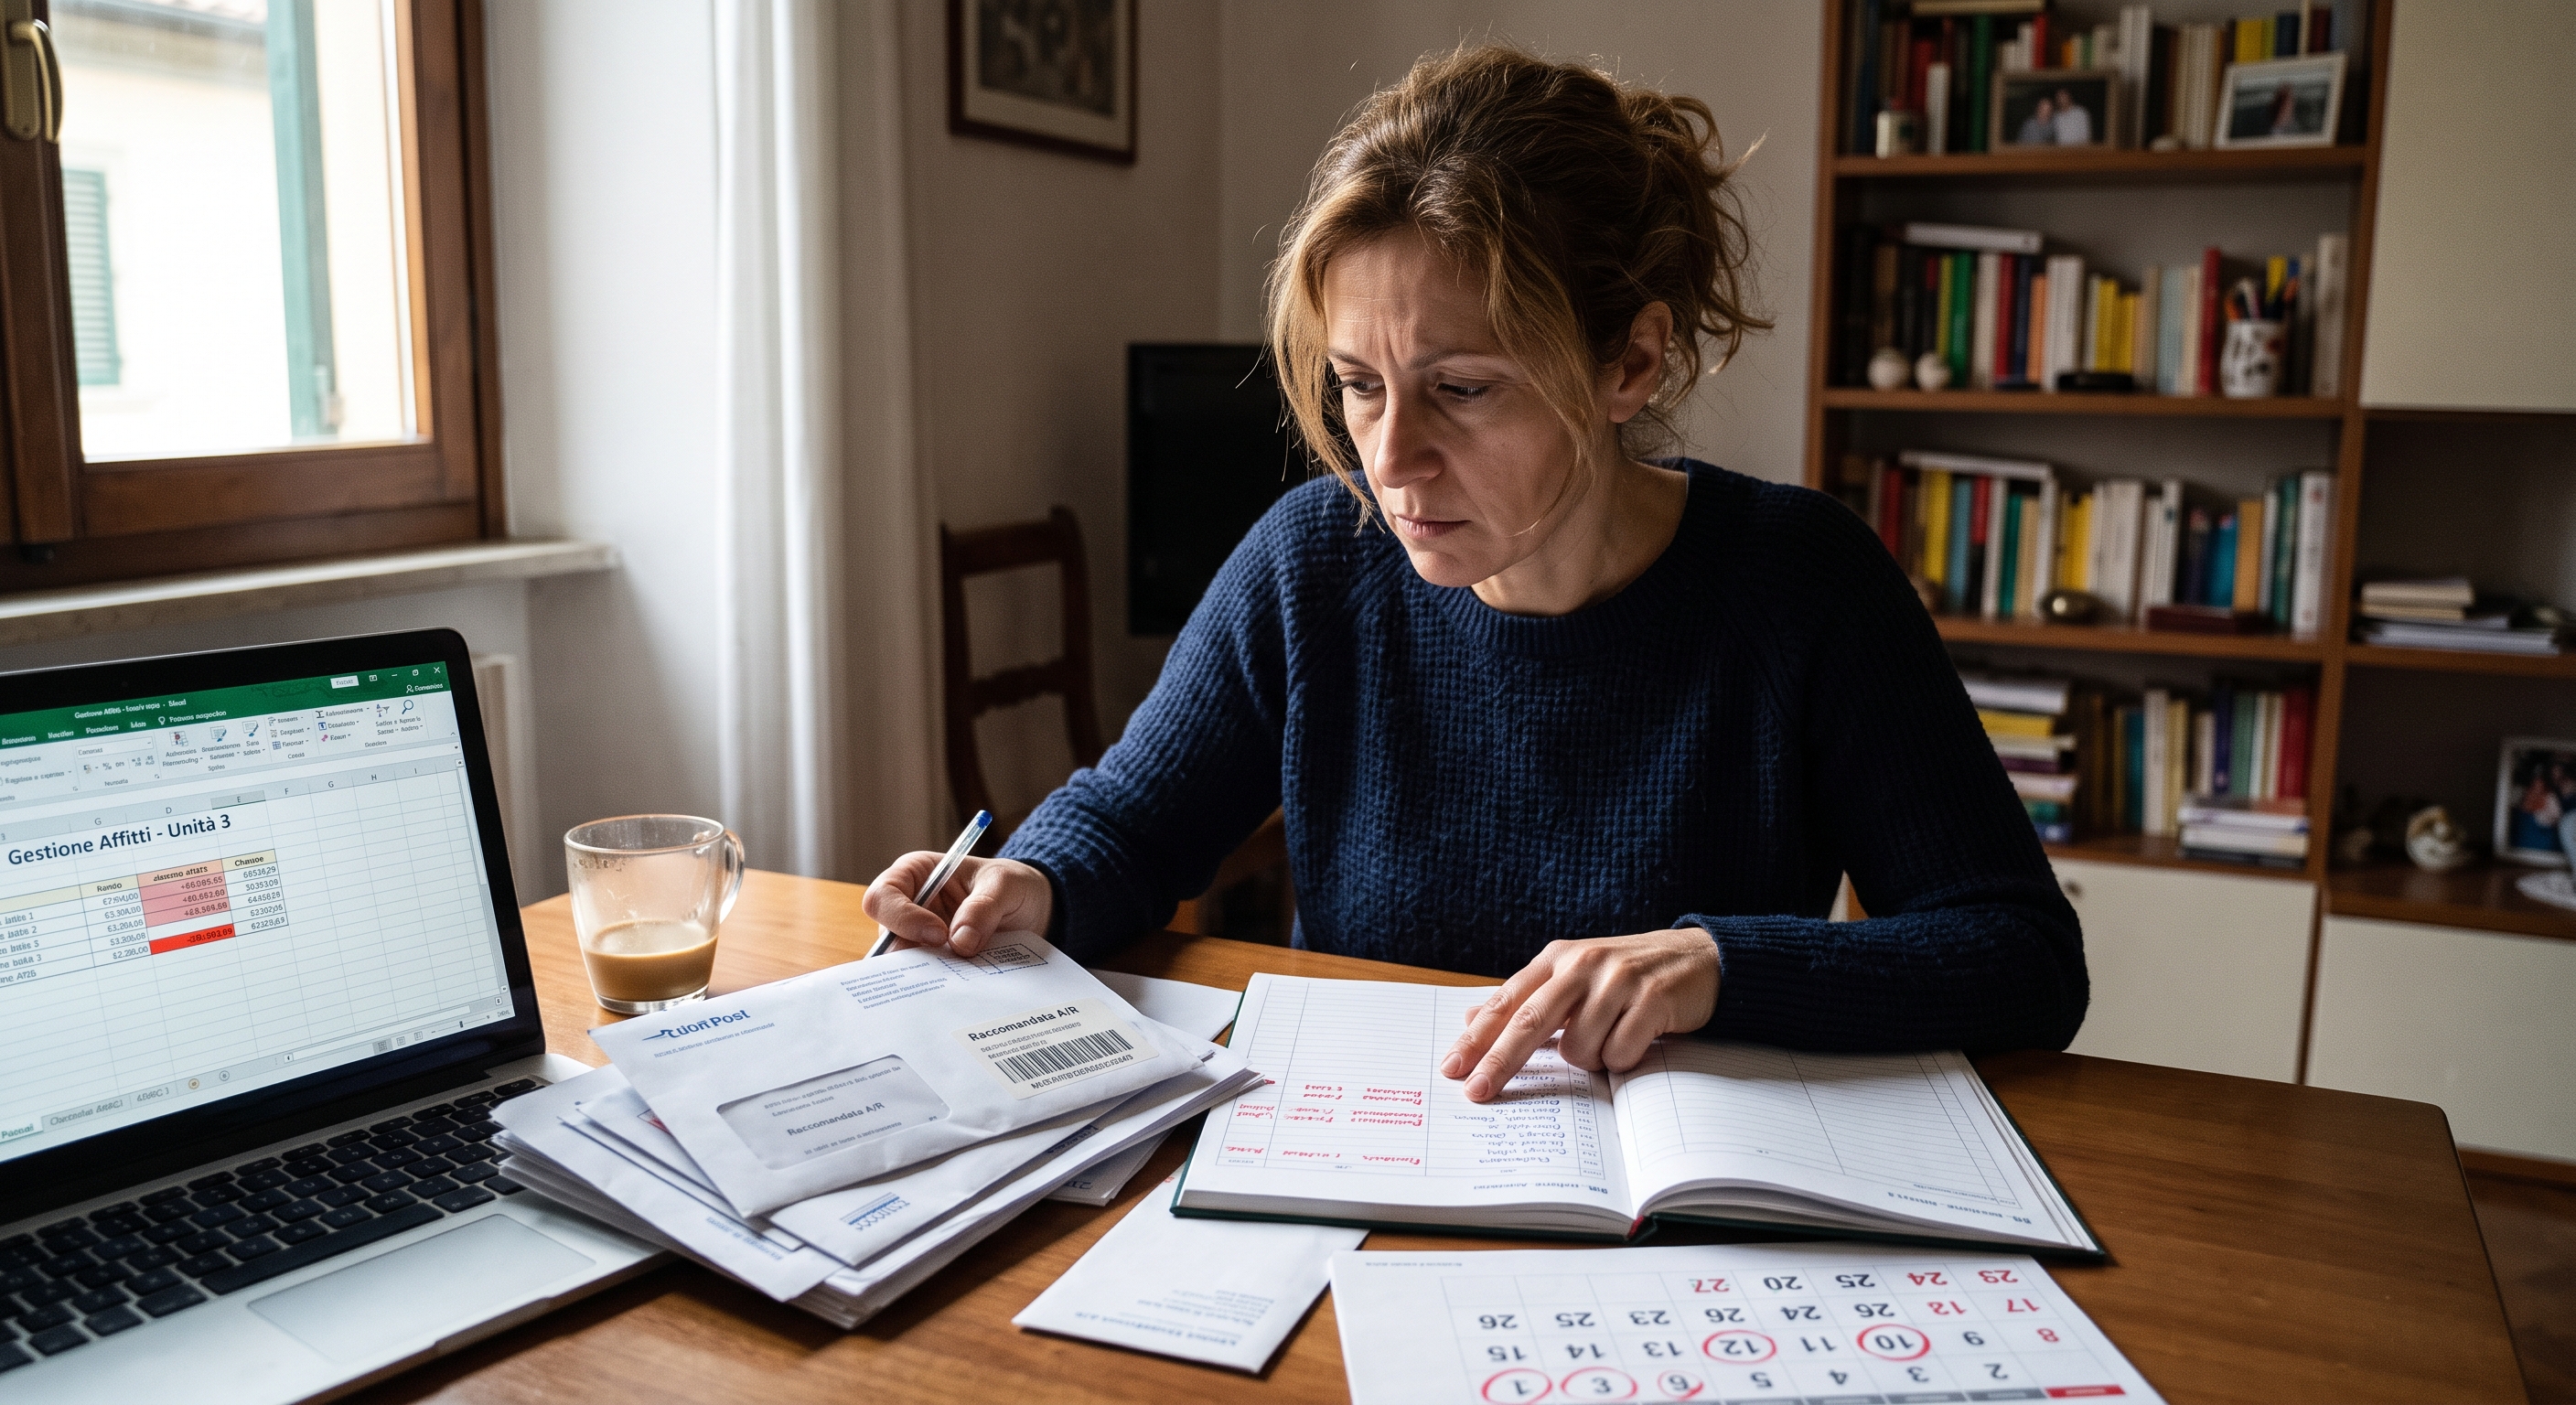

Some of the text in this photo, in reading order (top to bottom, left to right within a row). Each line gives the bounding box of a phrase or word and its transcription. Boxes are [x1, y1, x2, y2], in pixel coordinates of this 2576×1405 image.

[8, 841, 93, 865] Gestione
[99, 827, 151, 851] Affitti
[167, 816, 216, 838] Unità
[220, 814, 231, 829] 3
[1057, 1006, 1079, 1017] A/R
[865, 1101, 886, 1113] A/R
[1694, 1278, 1730, 1293] 27
[1764, 1276, 1802, 1291] 20
[1835, 1273, 1875, 1289] 25
[1906, 1271, 1948, 1286] 24
[1780, 1305, 1821, 1321] 24
[1854, 1303, 1894, 1318] 26
[2007, 1298, 2040, 1313] 17
[1478, 1314, 1518, 1329] 26
[1555, 1312, 1595, 1327] 25
[1628, 1310, 1670, 1325] 23
[1704, 1307, 1744, 1323] 26
[1874, 1334, 1914, 1350] 10
[2036, 1327, 2059, 1343] 8
[1566, 1343, 1605, 1359] 14
[1642, 1341, 1683, 1357] 13
[1719, 1338, 1759, 1356] 12
[1800, 1336, 1837, 1353] 11
[1487, 1346, 1527, 1361] 15
[1830, 1369, 1848, 1385] 4
[1906, 1366, 1929, 1382] 3
[1984, 1363, 2008, 1380] 2
[1513, 1379, 1530, 1396] 1
[1750, 1371, 1773, 1389] 5
